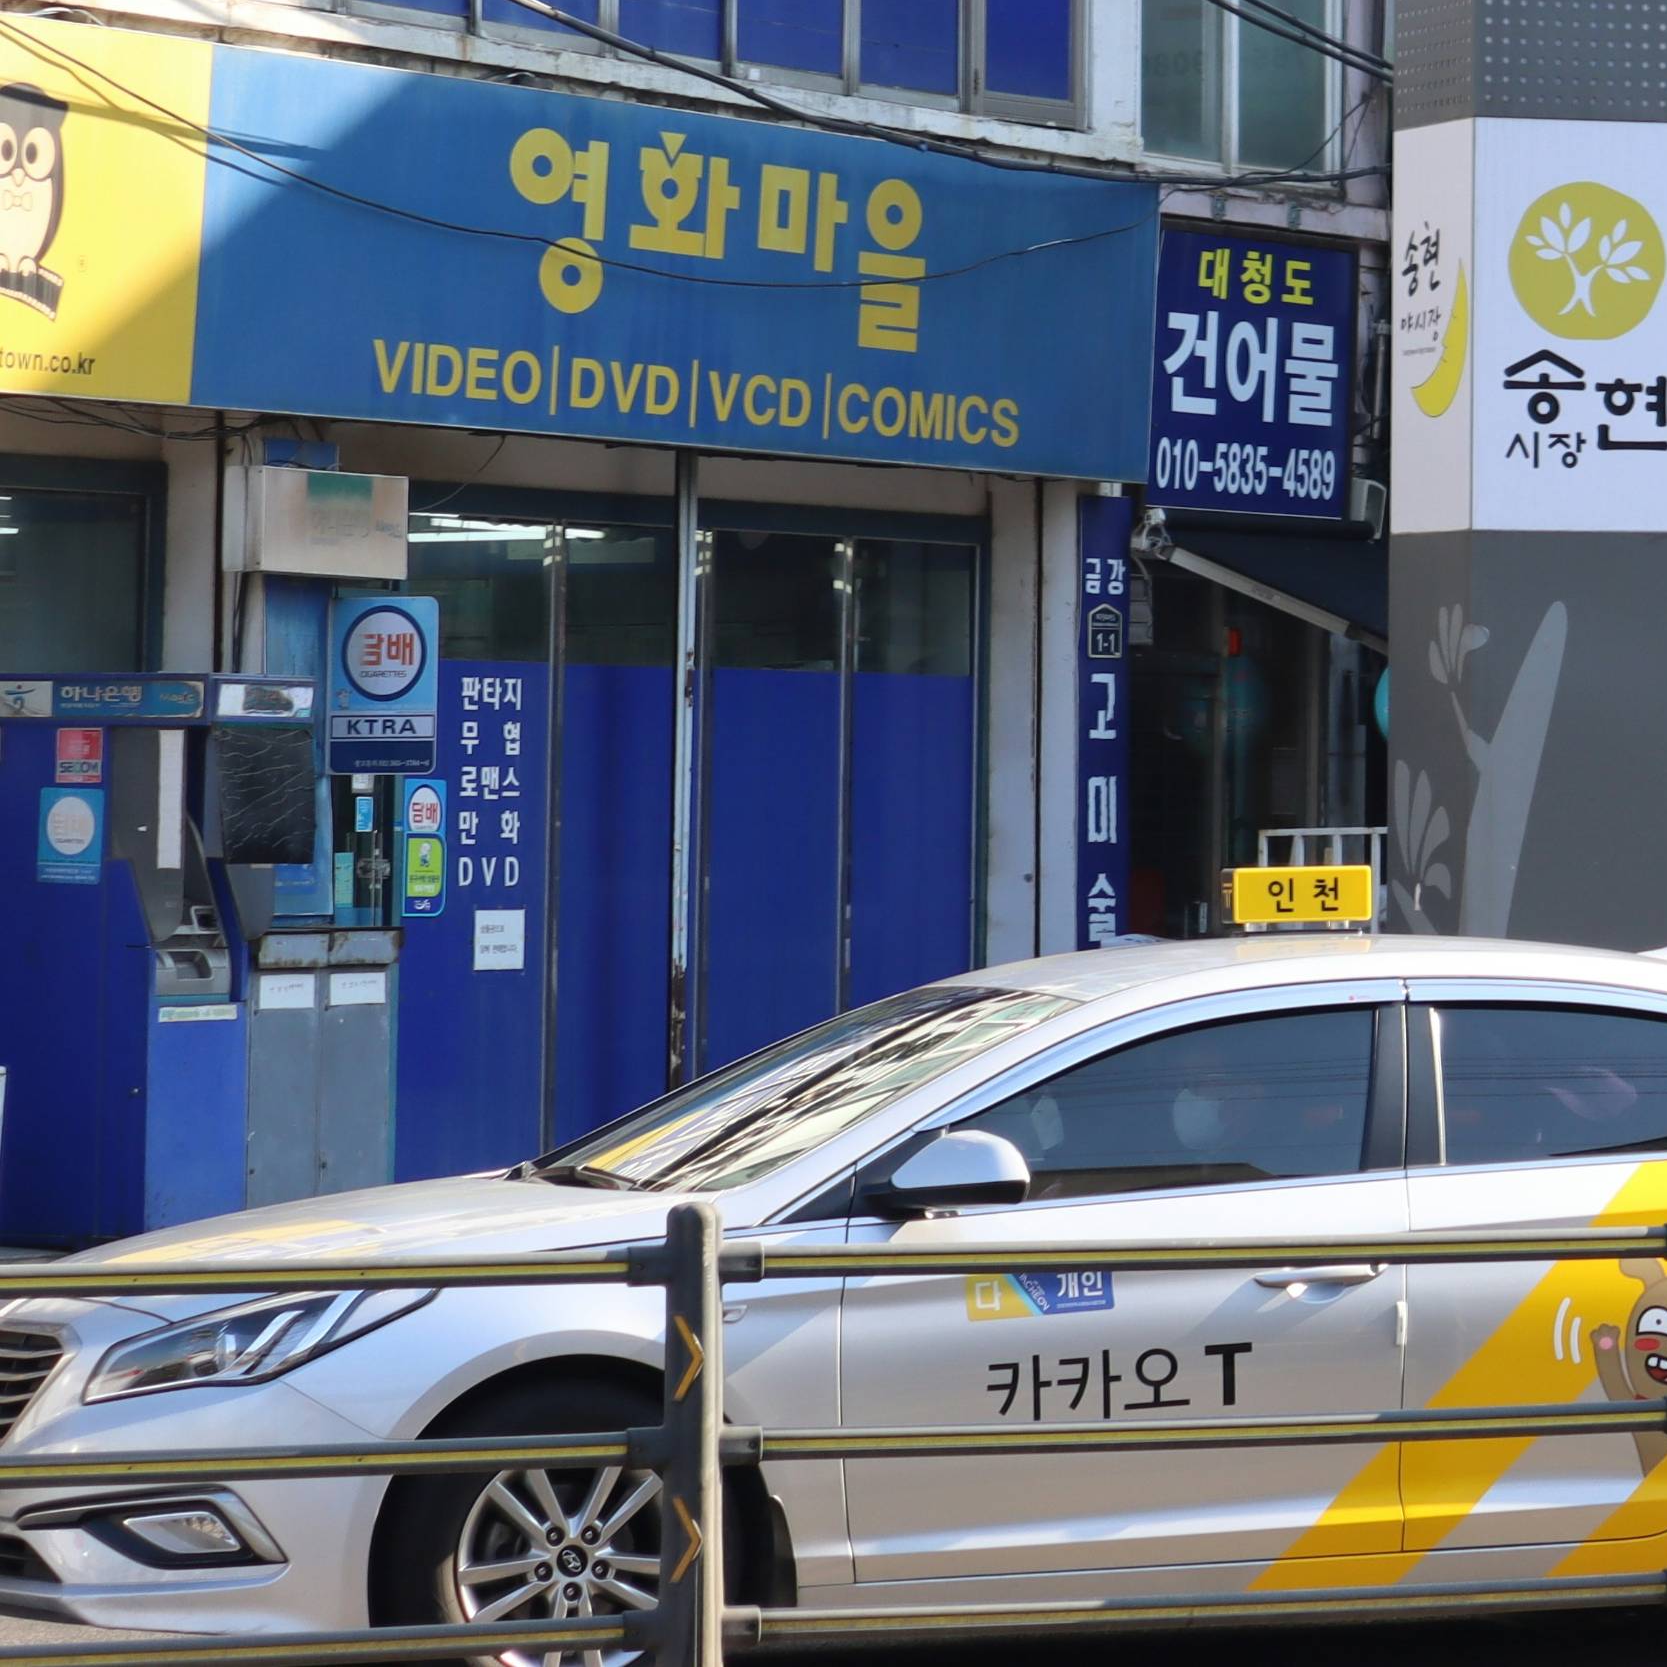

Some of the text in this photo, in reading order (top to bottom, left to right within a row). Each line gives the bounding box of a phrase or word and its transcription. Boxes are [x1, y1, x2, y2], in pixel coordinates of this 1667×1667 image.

[509, 126, 926, 353] 영화마을
[1401, 220, 1442, 297] 송현
[1198, 247, 1315, 306] 대청도
[1162, 309, 1340, 428] 건어물
[372, 338, 1021, 448] VIDEO DVD VCD COMICS
[1154, 435, 1338, 502] 010-5835-4589
[1504, 431, 1587, 470] 시장
[1085, 557, 1126, 595] 금강
[60, 685, 144, 702] 하나은행
[461, 676, 523, 712] 판타지
[346, 718, 417, 735] KTRA
[459, 765, 521, 801] 로맨스
[1266, 875, 1341, 914] 인천
[1056, 1270, 1104, 1299] 개인
[986, 1341, 1253, 1422] 카카오 T
